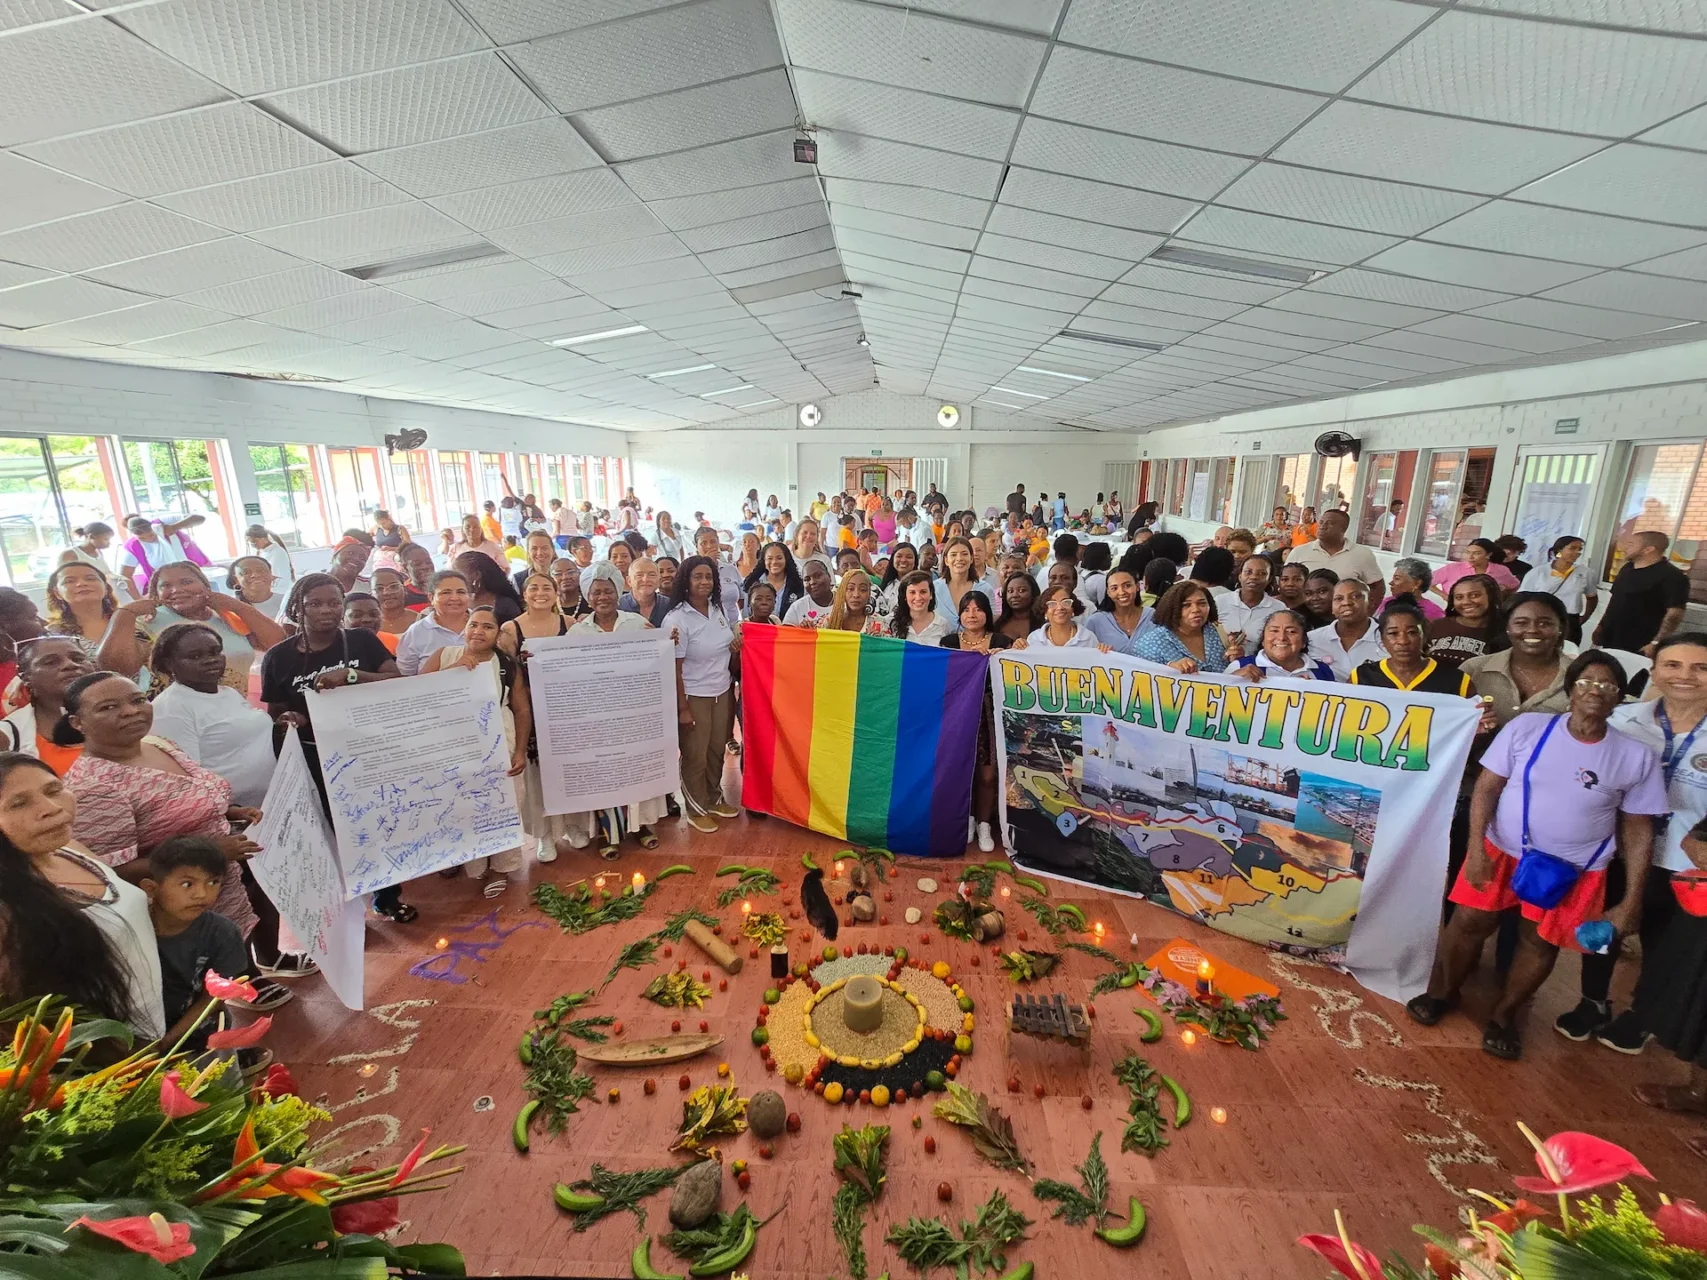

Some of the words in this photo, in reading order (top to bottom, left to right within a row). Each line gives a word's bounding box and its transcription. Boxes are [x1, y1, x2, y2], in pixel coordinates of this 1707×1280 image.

[1429, 636, 1452, 652] LOS
[1449, 635, 1486, 656] ANGEL
[998, 658, 1434, 771] BUENAVENTURA
[1020, 771, 1026, 779] 1
[1053, 791, 1060, 799] 2
[1063, 819, 1070, 828] 3
[1217, 823, 1226, 834] 6
[1141, 832, 1149, 842] 7
[1172, 854, 1180, 864] 8
[1199, 873, 1214, 885] 11
[1278, 874, 1295, 888] 10
